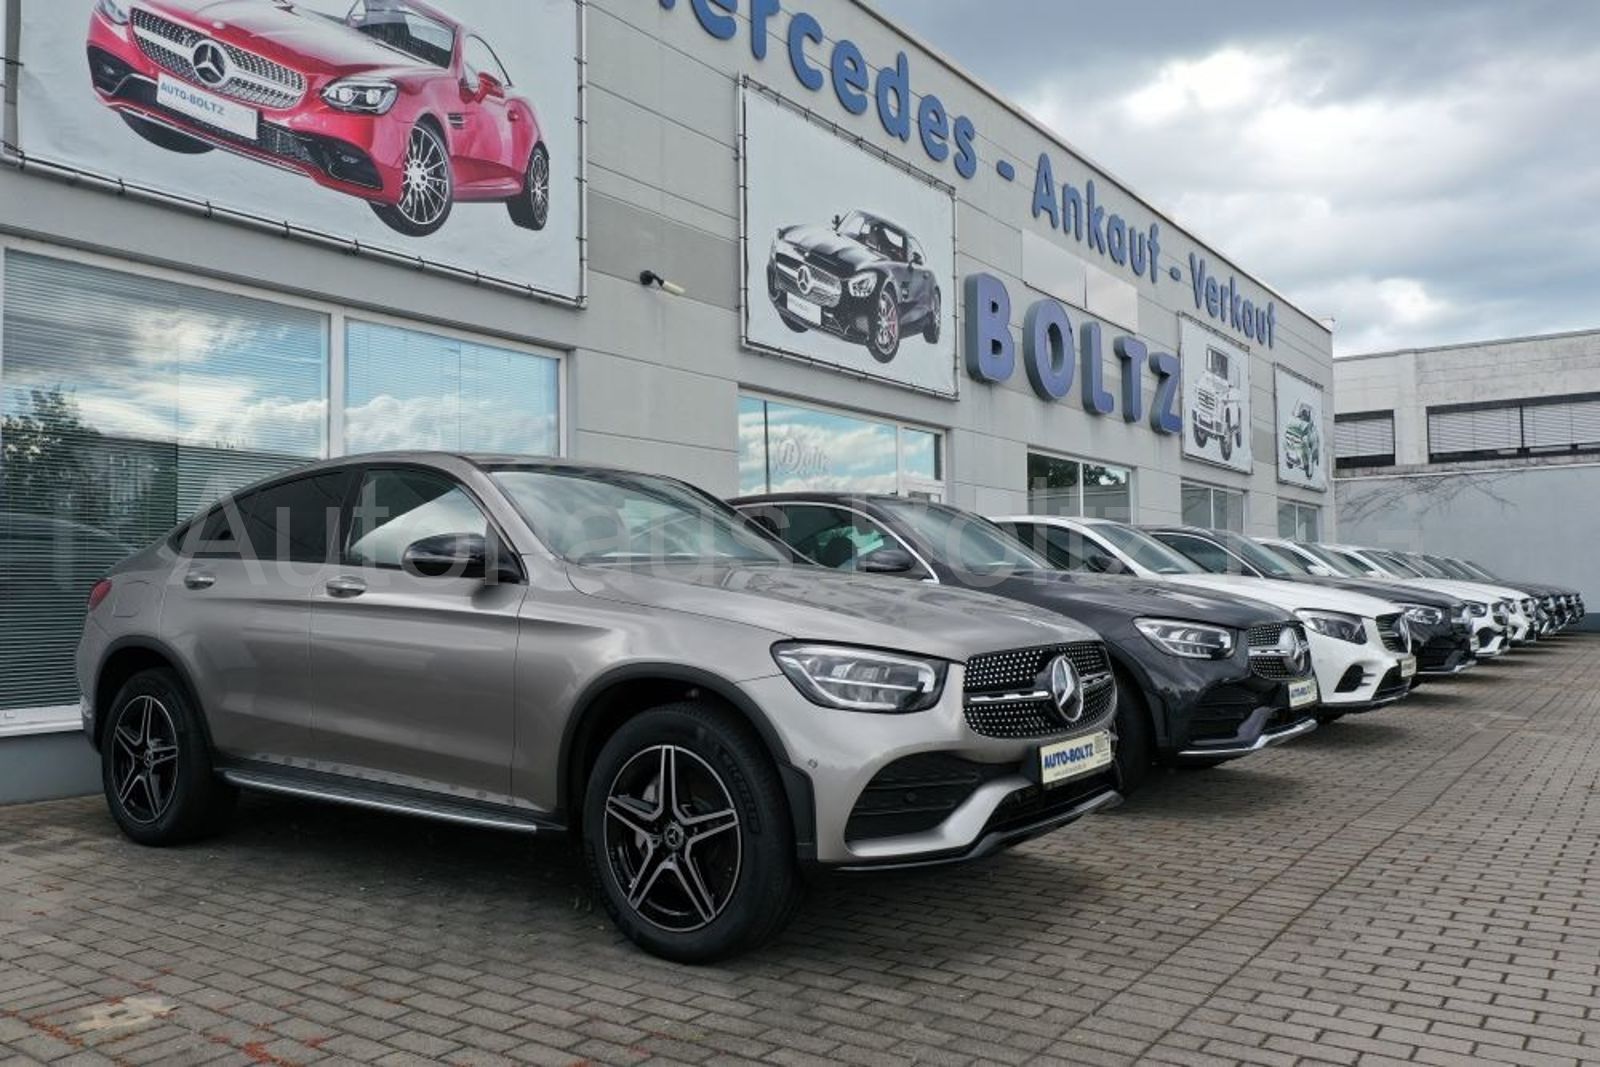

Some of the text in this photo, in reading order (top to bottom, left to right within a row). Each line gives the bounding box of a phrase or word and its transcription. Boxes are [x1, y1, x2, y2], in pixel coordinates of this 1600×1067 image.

[161, 82, 225, 116] AUTO-BOLTZ
[659, 0, 977, 180] ercedes
[1032, 152, 1160, 284] Ankauf
[1189, 252, 1275, 350] Verkauf
[964, 272, 1183, 435] BOLTZ
[1044, 742, 1094, 769] AUTO-BOLTZ
